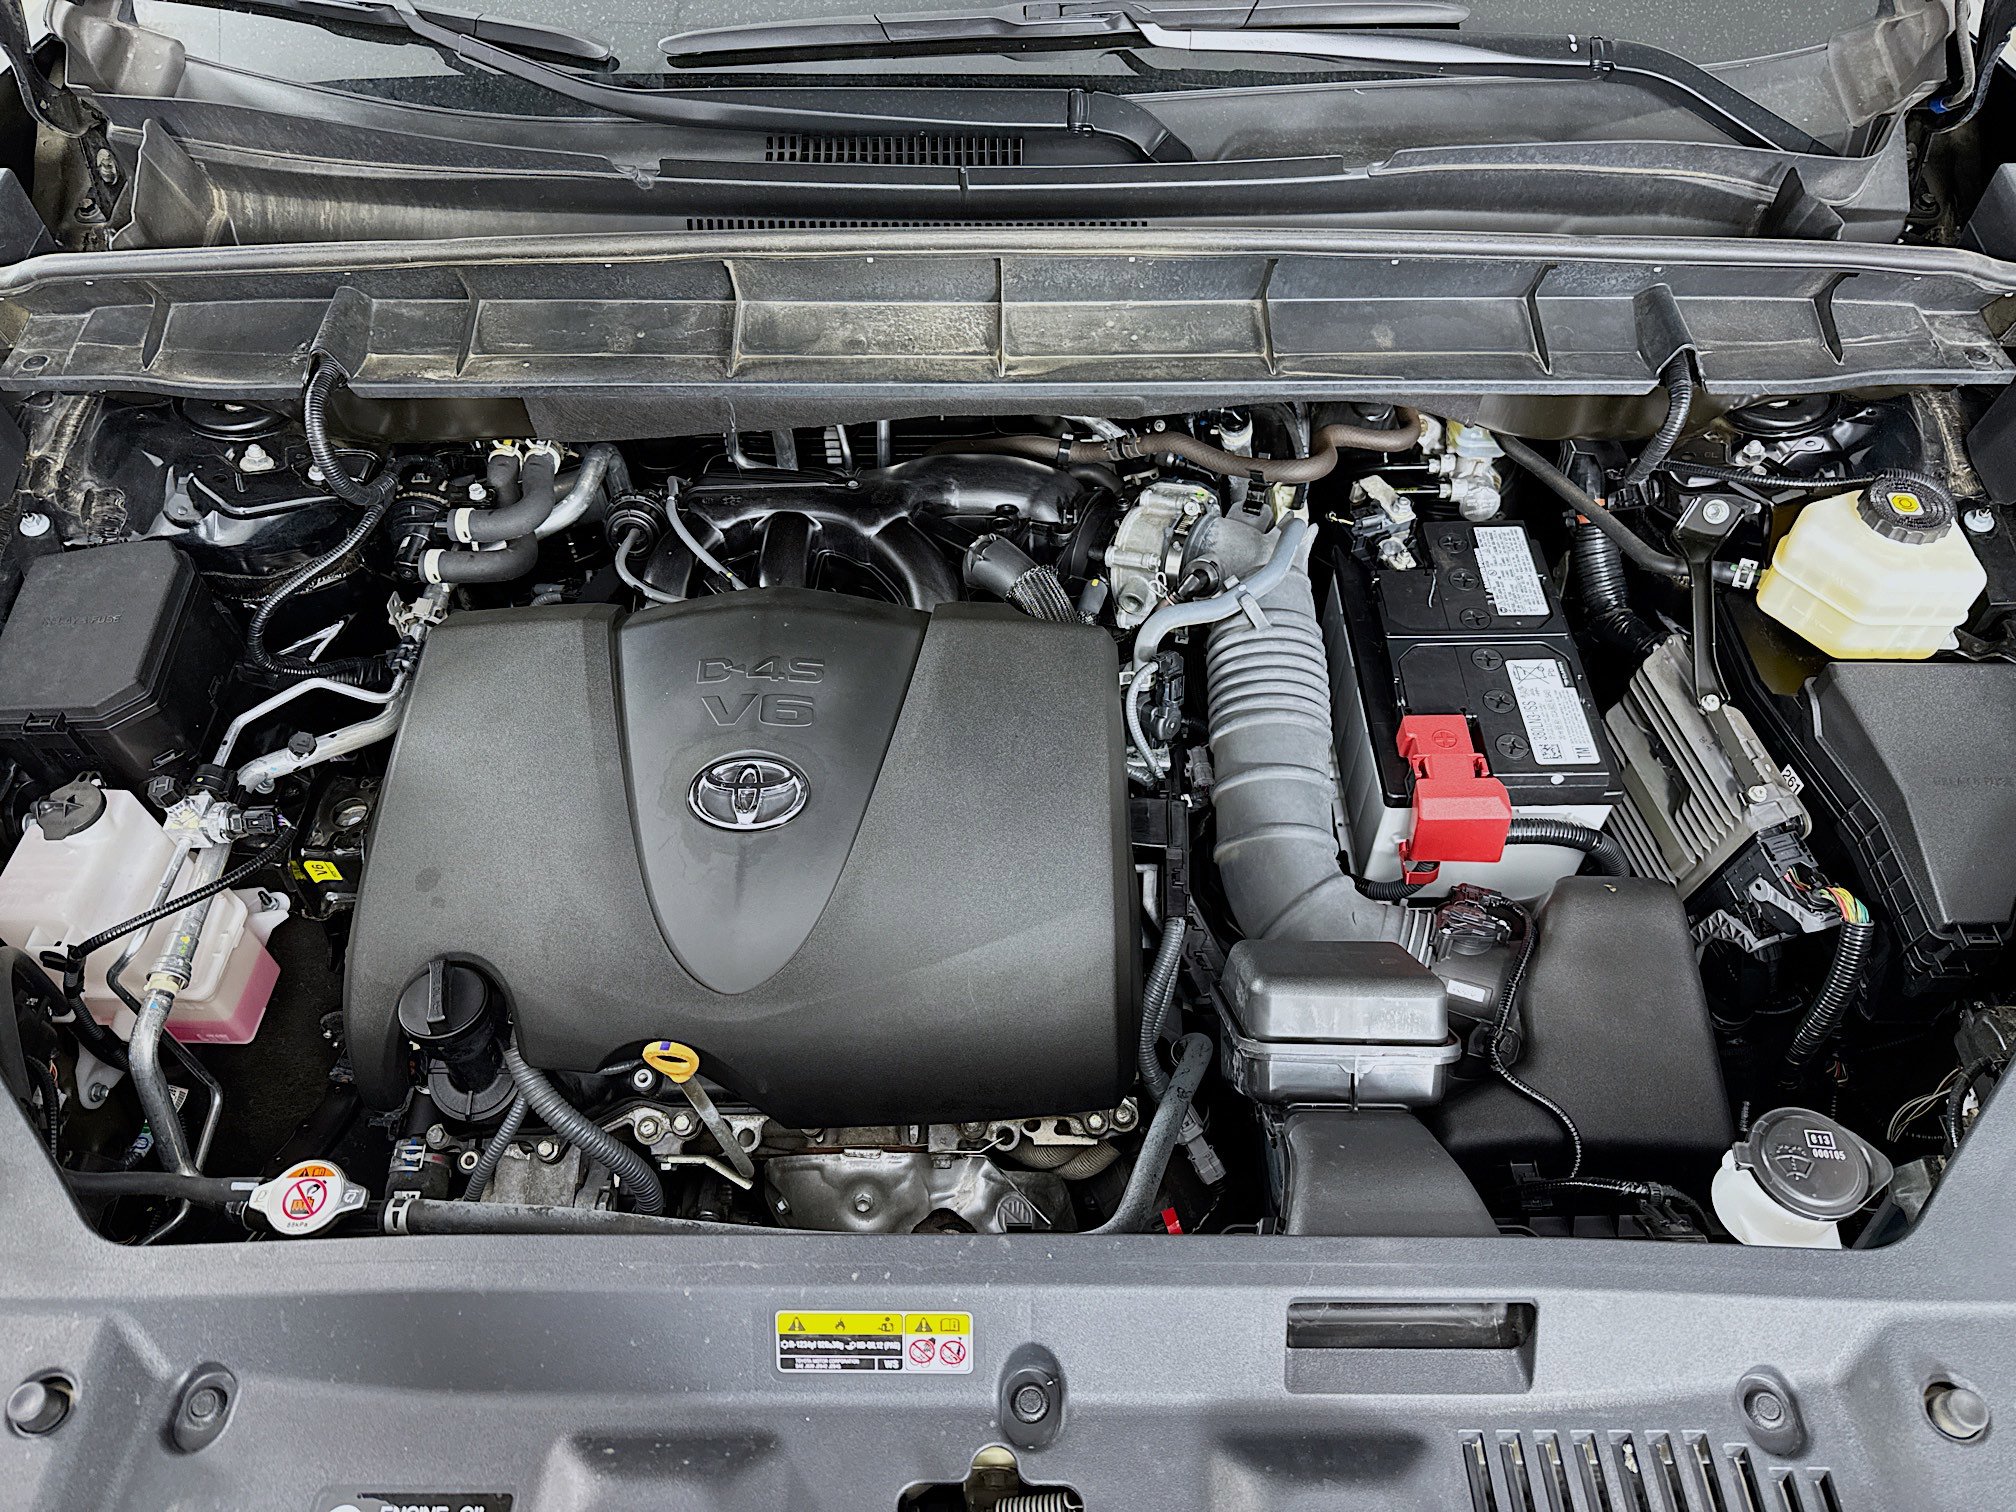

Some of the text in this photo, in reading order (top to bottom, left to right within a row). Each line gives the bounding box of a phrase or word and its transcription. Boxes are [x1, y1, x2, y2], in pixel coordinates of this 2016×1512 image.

[696, 656, 825, 684] D-4S
[701, 693, 815, 728] V6
[152, 778, 170, 793] H
[1782, 769, 1801, 794] 261
[1812, 1148, 1846, 1161] 000105
